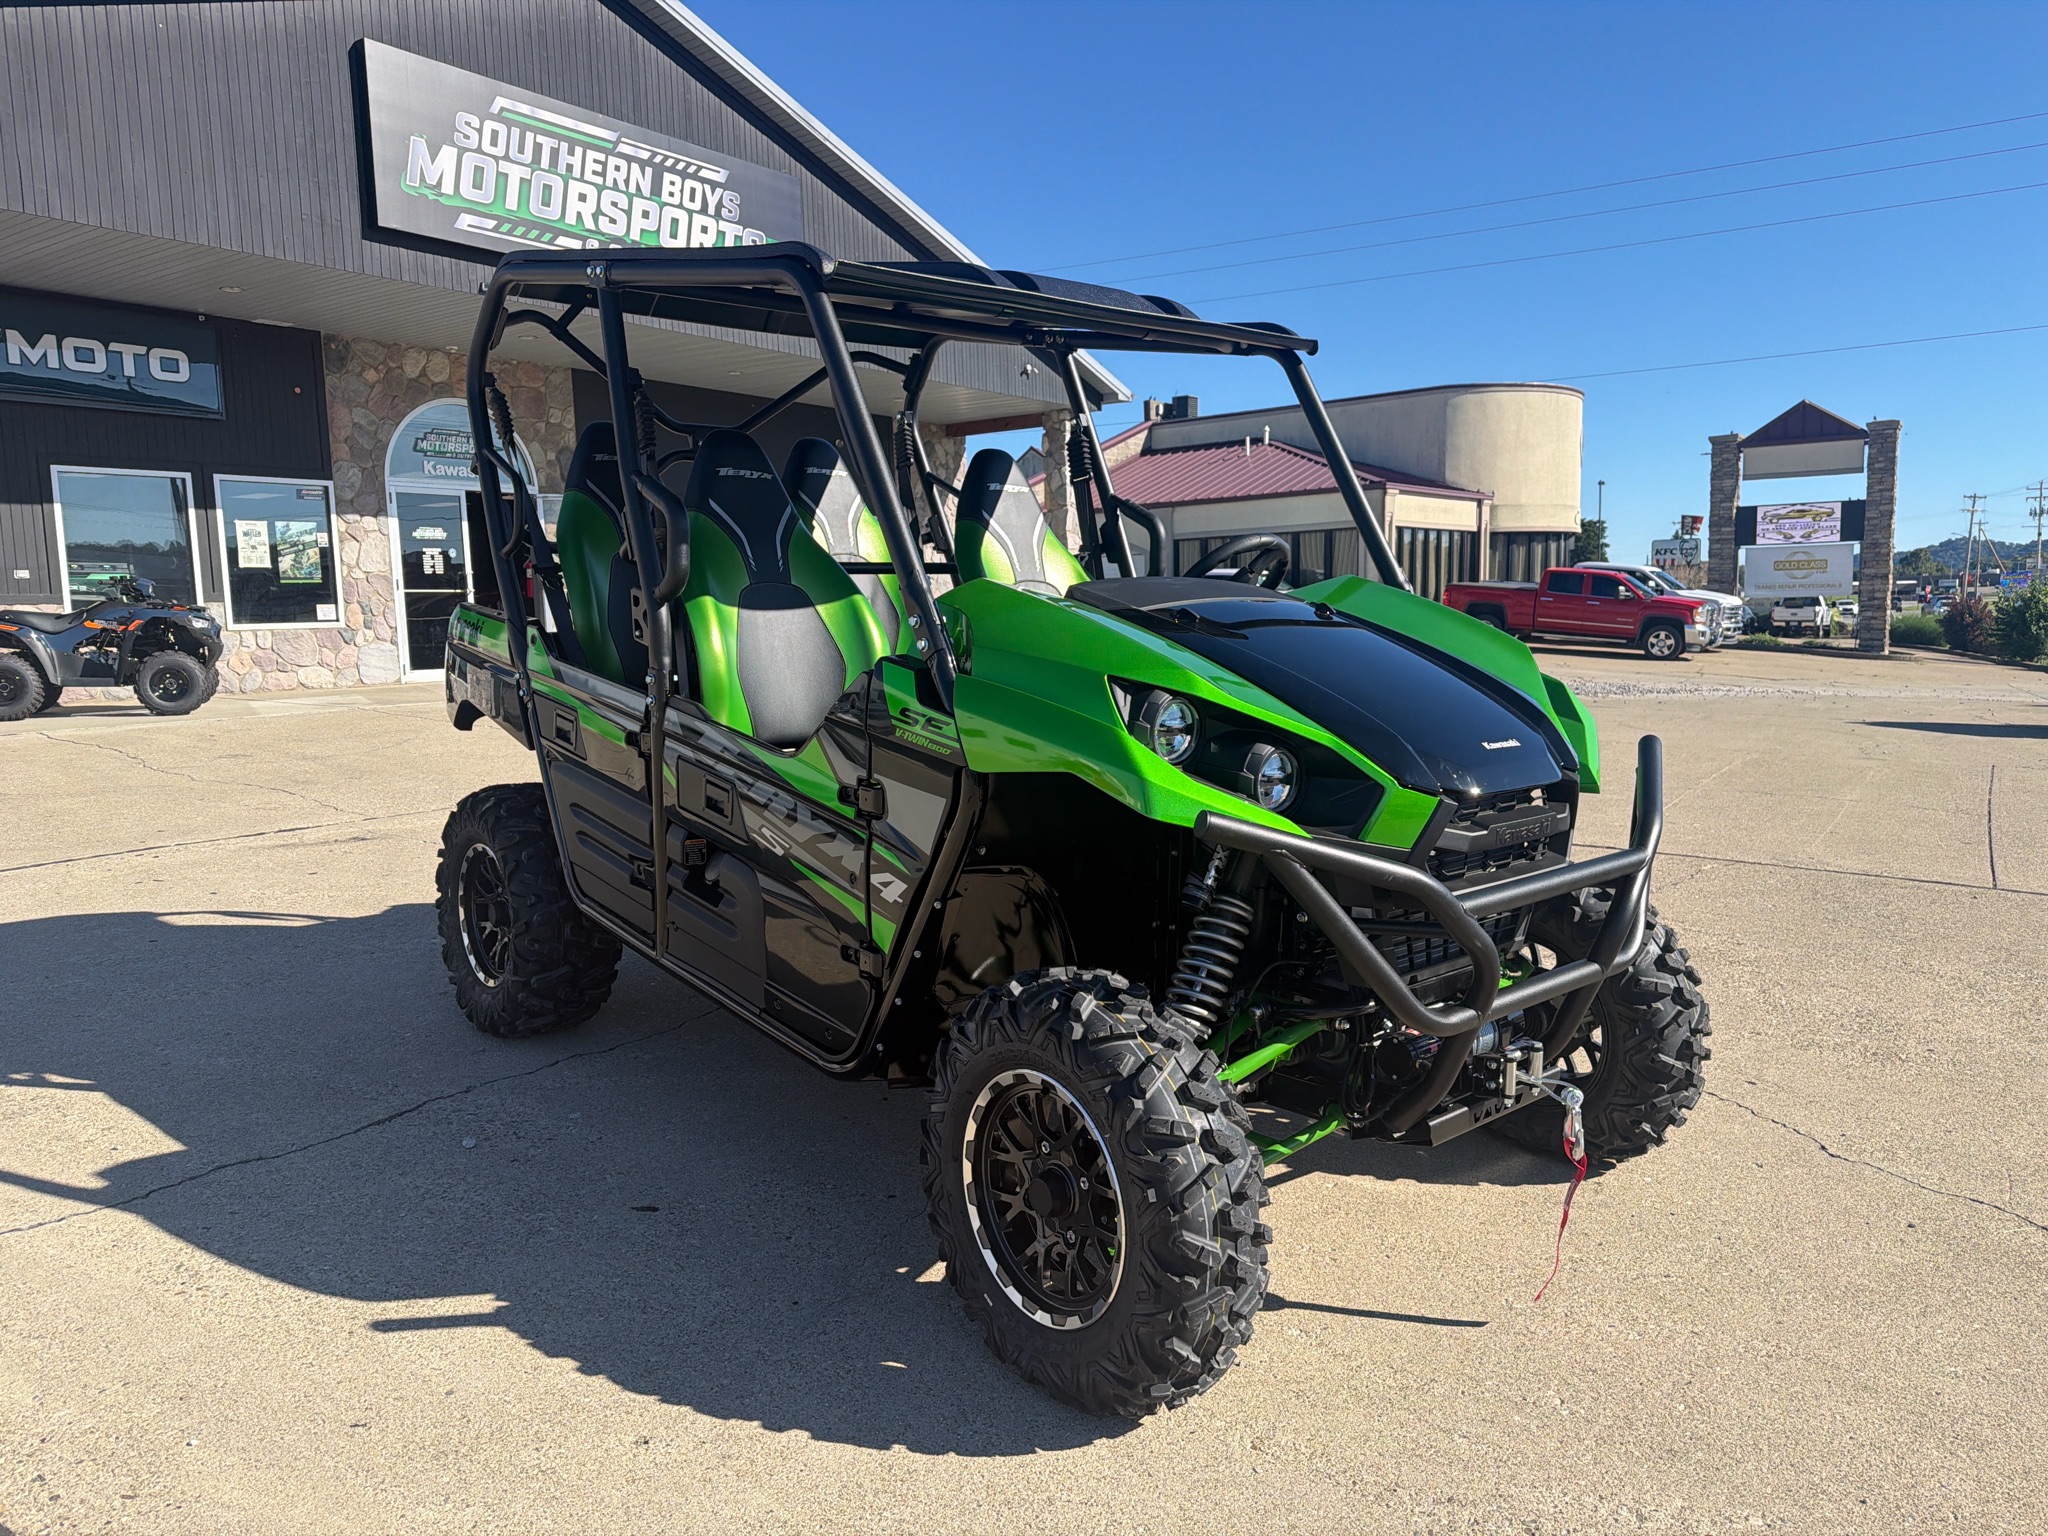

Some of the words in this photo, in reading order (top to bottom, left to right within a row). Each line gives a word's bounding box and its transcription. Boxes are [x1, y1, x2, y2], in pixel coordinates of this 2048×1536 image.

[454, 111, 653, 196] SOUTHERN
[661, 168, 741, 221] BOYS
[416, 439, 475, 454] MOTORSPO
[425, 433, 468, 445] SOUTHERN
[423, 460, 478, 478] Kawas
[715, 467, 774, 480] TERYX
[1655, 548, 1677, 556] KFC
[1774, 561, 1798, 570] GOLD
[1799, 560, 1827, 569] CLASS
[897, 706, 956, 738] SE
[1481, 738, 1522, 750] Kawasaki
[1495, 817, 1552, 845] Kawasaki
[870, 872, 909, 904] 4
